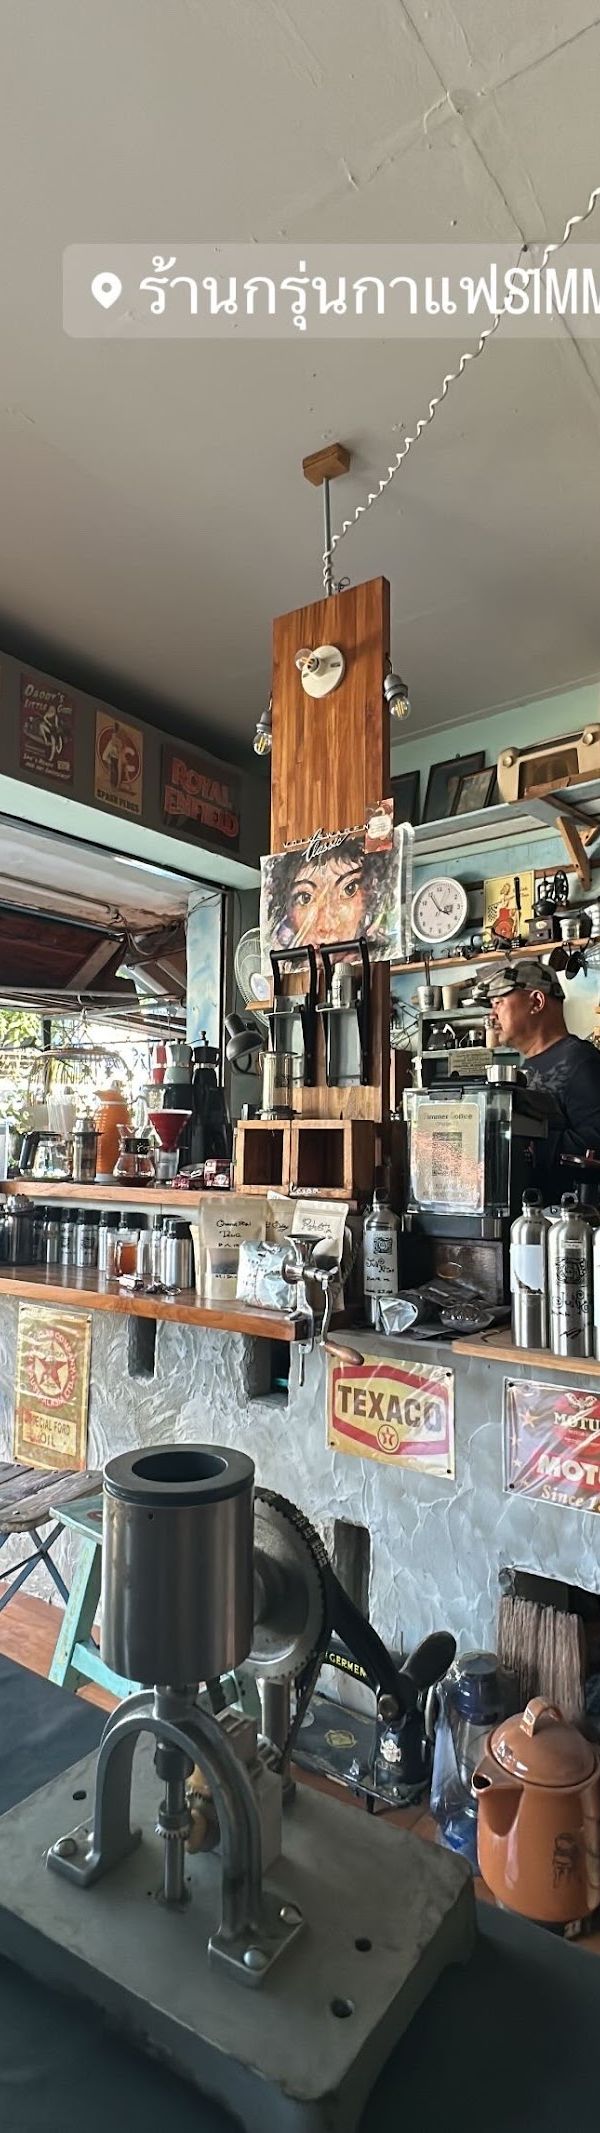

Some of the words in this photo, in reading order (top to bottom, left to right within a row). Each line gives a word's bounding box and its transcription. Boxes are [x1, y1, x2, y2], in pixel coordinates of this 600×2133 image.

[170, 758, 231, 807] ROYAL
[164, 784, 240, 839] ENFIELD
[337, 1384, 445, 1432] TEXACO
[553, 1411, 600, 1431] MOTU
[536, 1454, 600, 1486] MOT
[541, 1484, 584, 1507] Since
